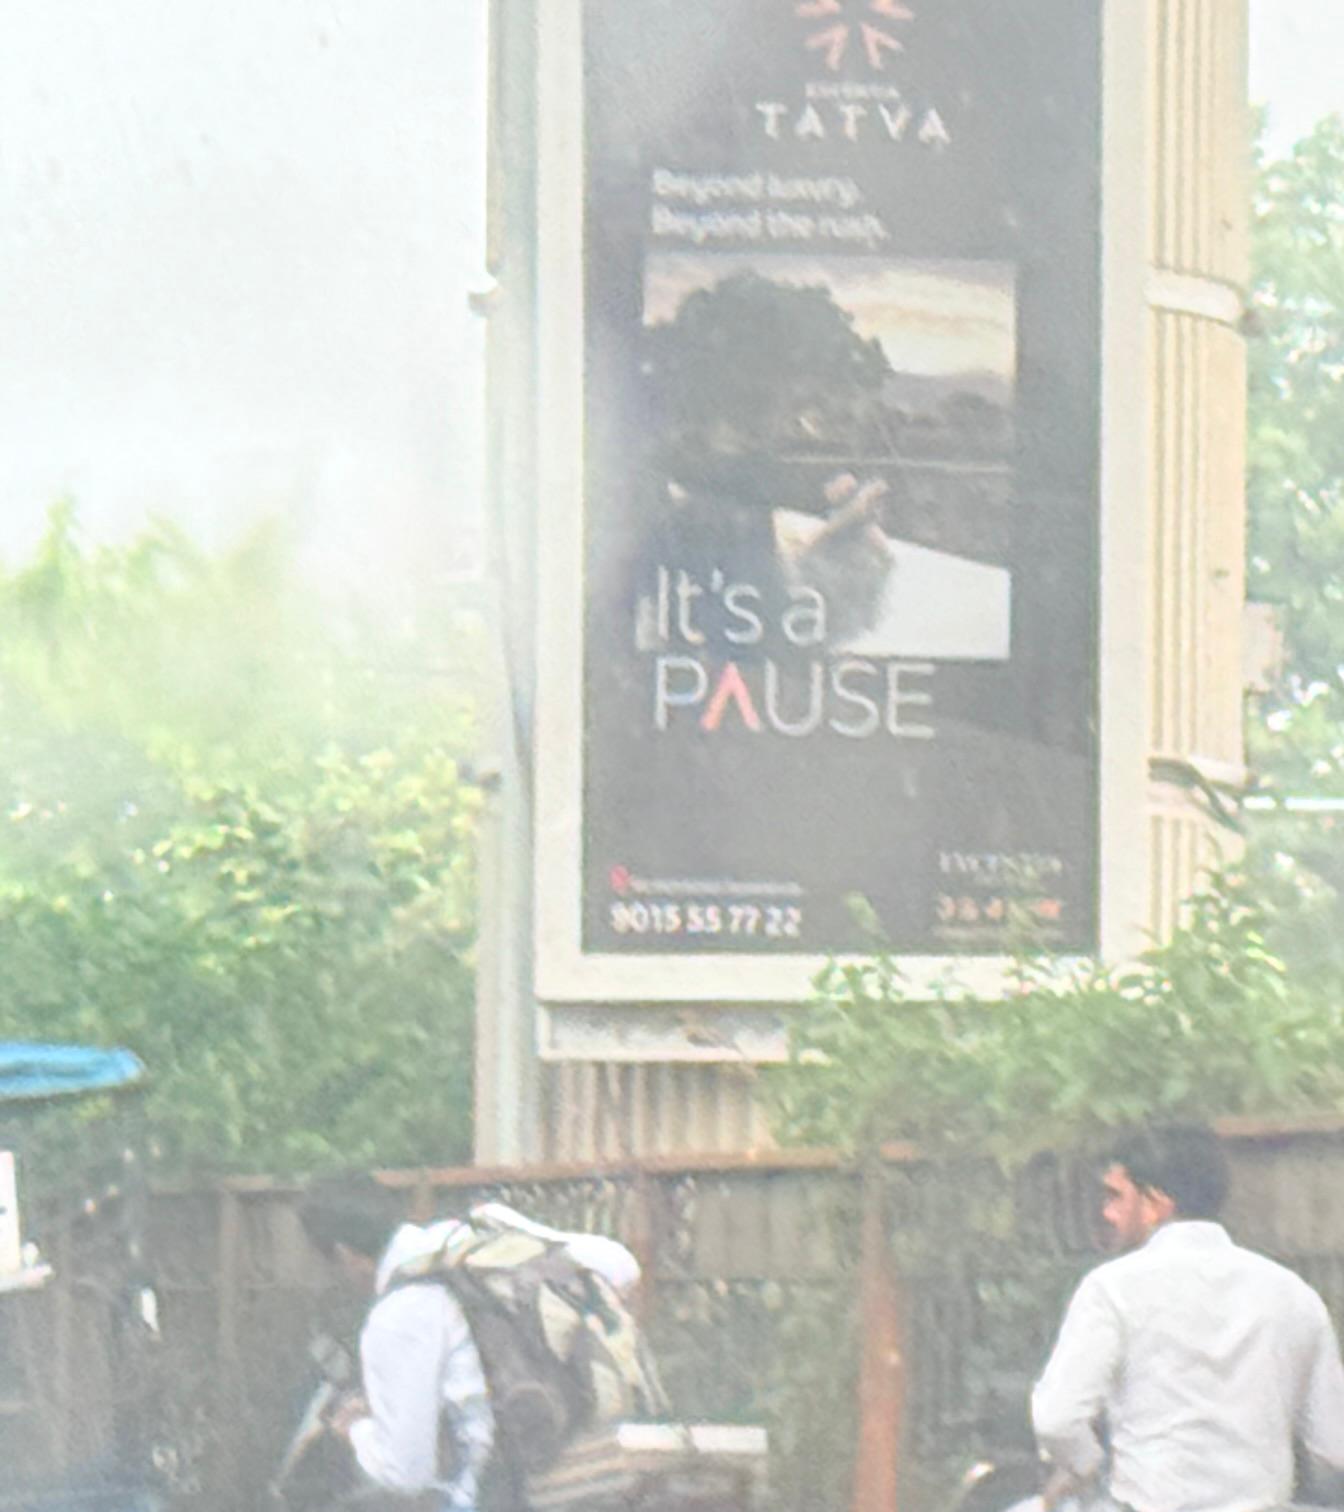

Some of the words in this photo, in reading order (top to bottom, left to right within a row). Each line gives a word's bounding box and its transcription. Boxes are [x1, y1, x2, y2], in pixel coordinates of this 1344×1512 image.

[755, 101, 951, 145] TATVA
[657, 564, 764, 645] It's
[781, 585, 826, 646] a
[655, 654, 936, 739] PAUSE
[728, 904, 762, 935] 77
[764, 905, 801, 937] 22
